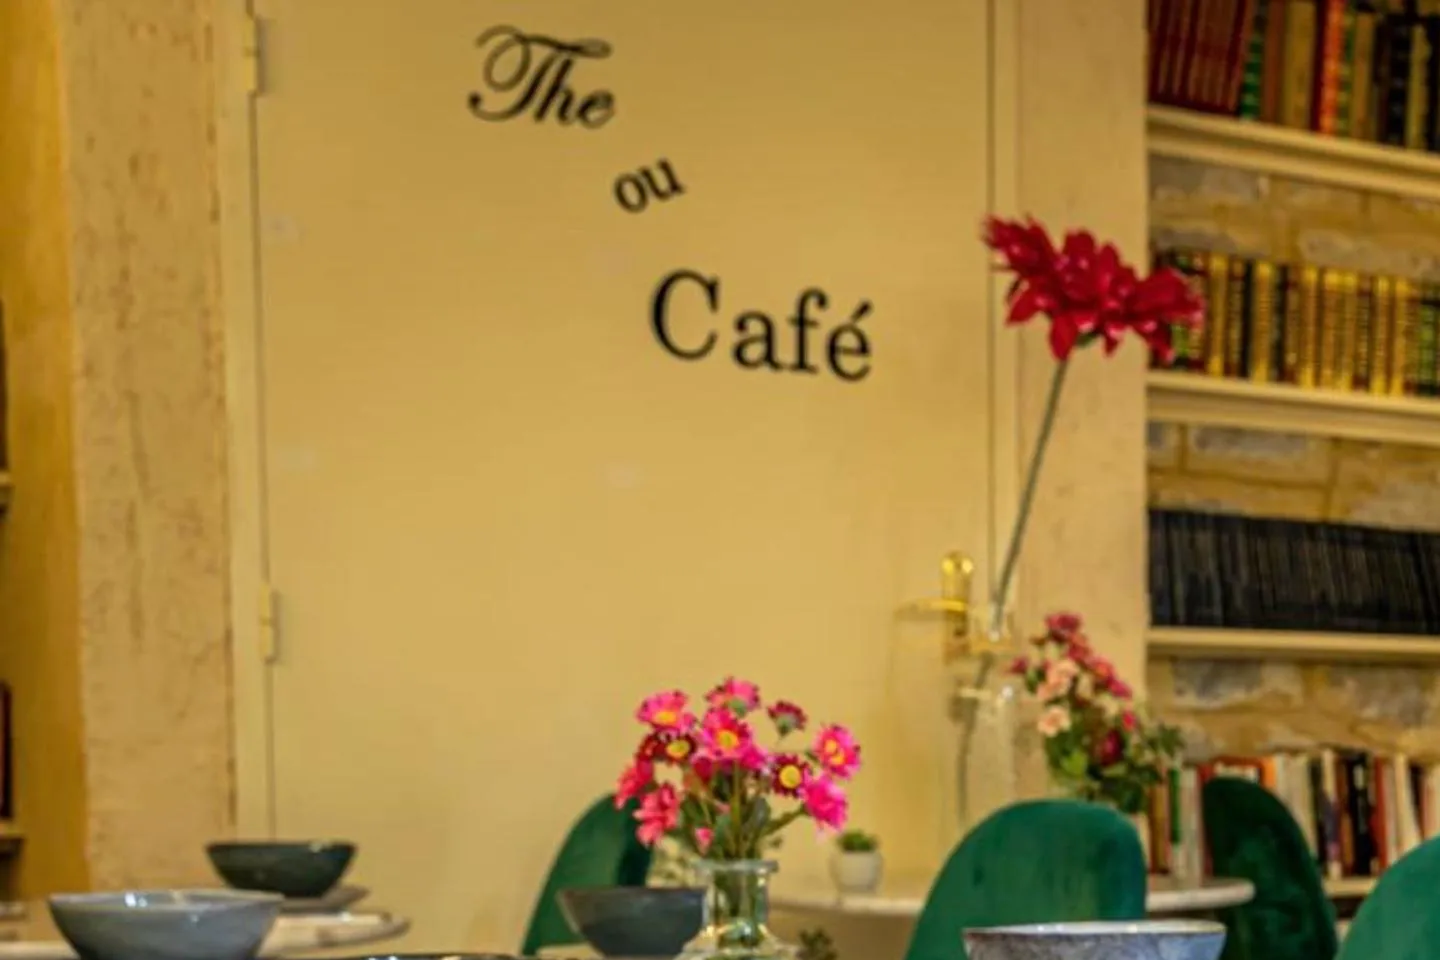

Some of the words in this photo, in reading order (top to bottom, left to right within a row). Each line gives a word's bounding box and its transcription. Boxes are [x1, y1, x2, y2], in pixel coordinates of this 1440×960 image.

[467, 25, 616, 129] The
[613, 158, 686, 214] ou
[649, 269, 873, 382] Café
